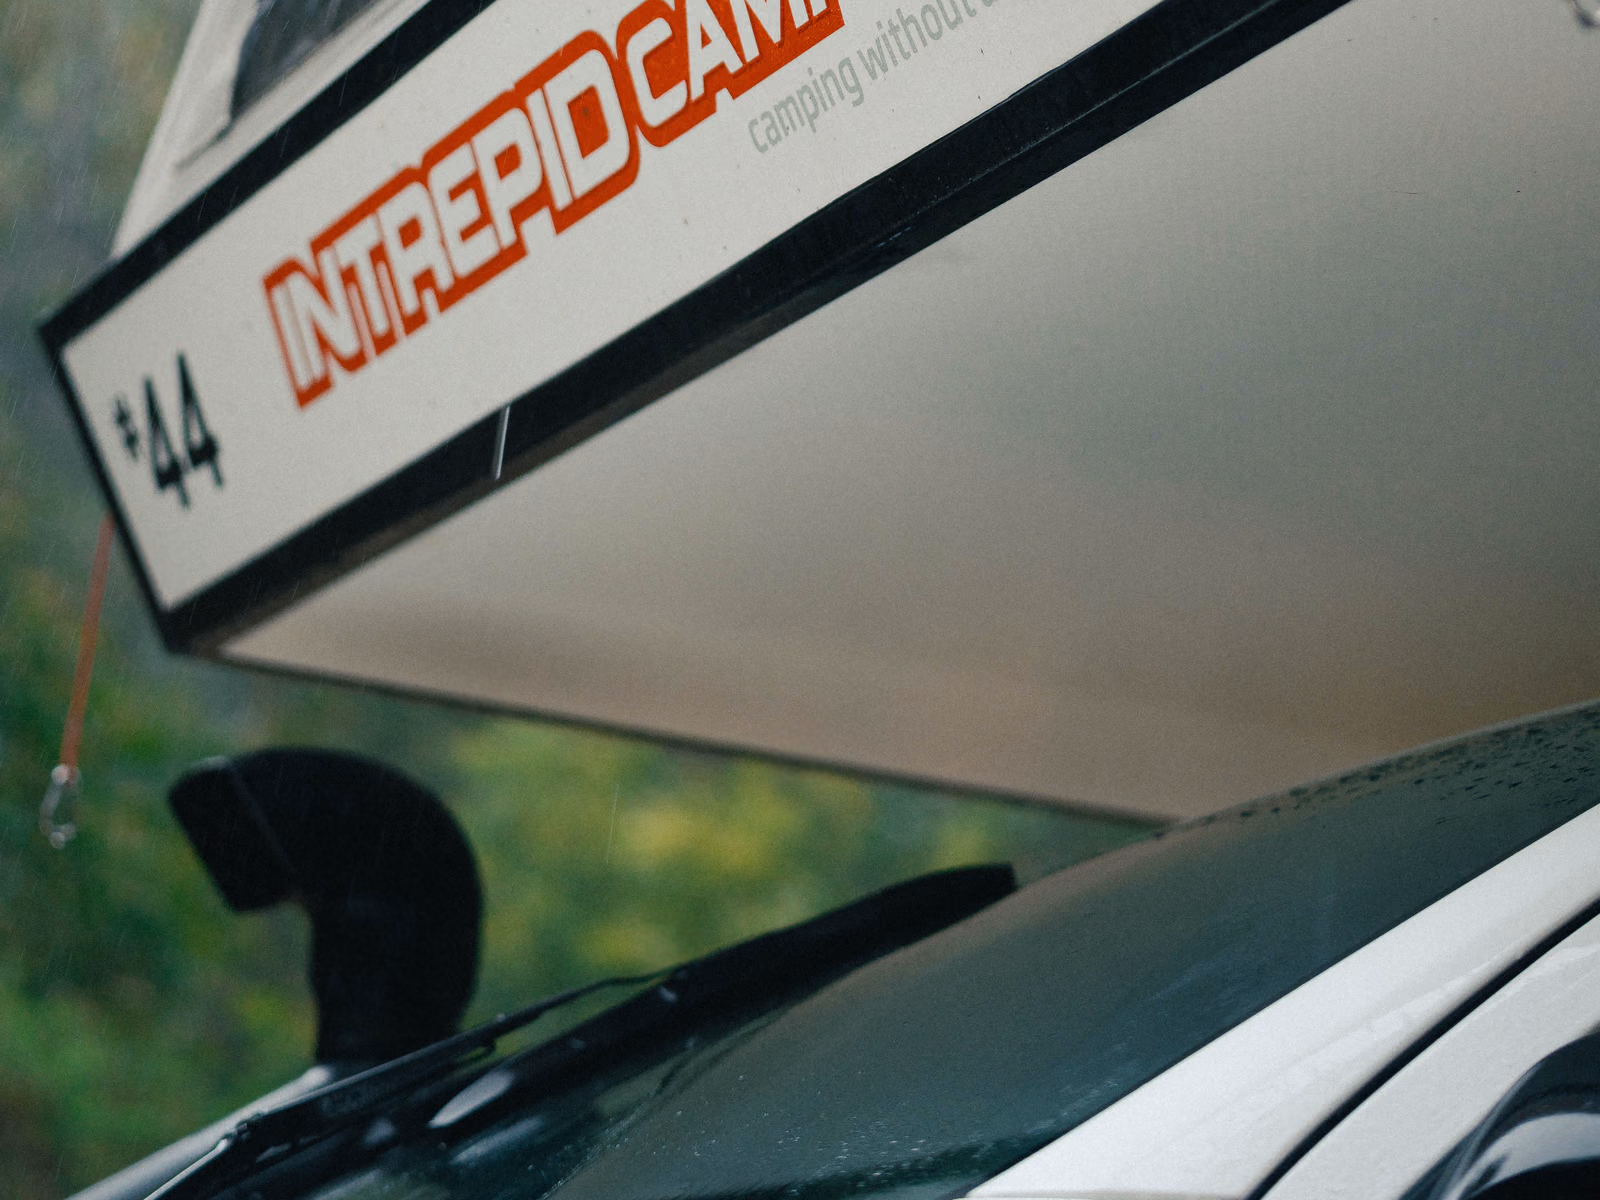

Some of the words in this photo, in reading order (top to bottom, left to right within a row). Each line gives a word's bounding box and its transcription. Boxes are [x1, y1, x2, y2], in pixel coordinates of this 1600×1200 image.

[748, 57, 865, 153] camping
[268, 44, 634, 394] INTREPID
[113, 352, 223, 511] #44
